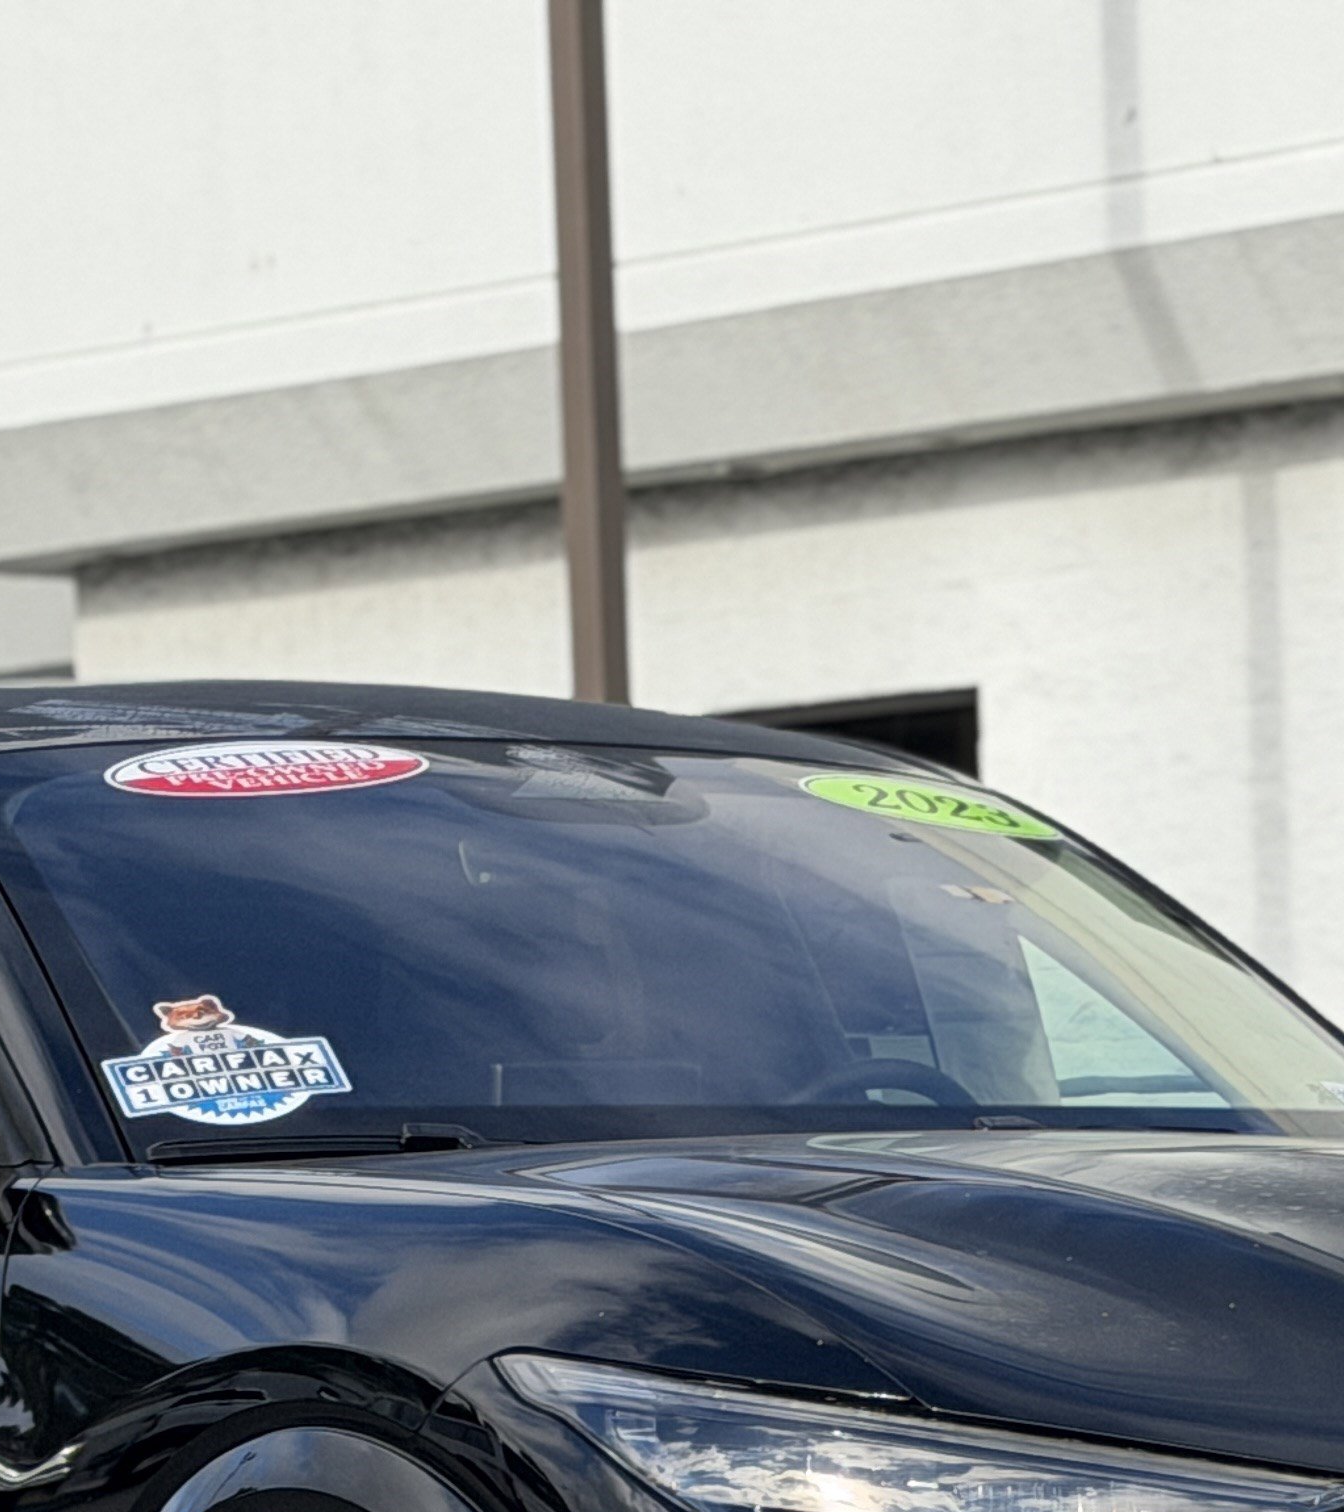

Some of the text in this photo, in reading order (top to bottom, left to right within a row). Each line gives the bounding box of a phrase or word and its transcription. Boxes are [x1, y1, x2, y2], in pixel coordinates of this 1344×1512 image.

[138, 749, 380, 775] CERTIFIED
[211, 772, 370, 790] VEHICLE
[194, 1033, 225, 1043] CAR
[125, 1049, 322, 1083] CARFAX
[136, 1067, 331, 1105] 1 OWNER
